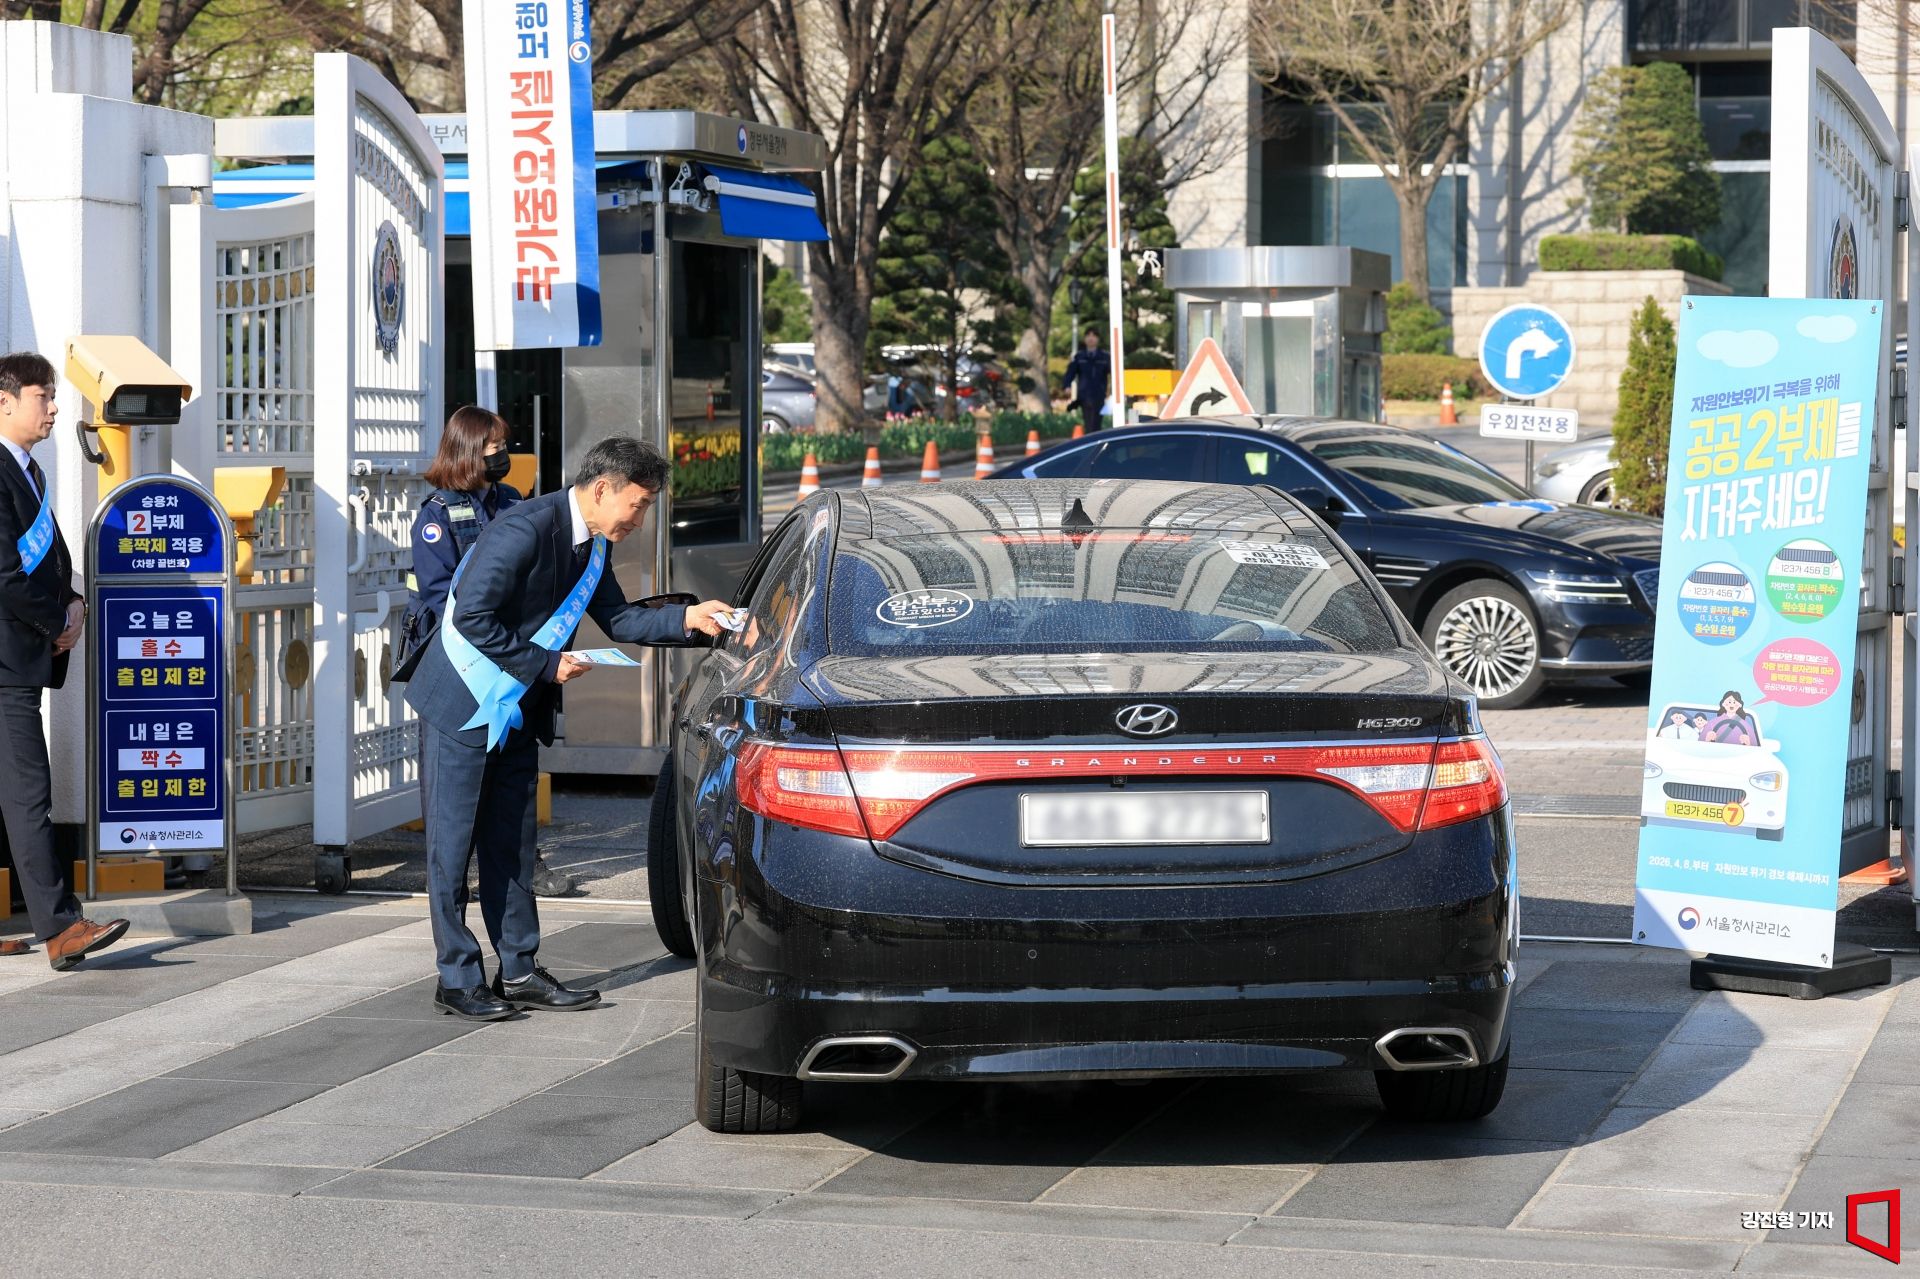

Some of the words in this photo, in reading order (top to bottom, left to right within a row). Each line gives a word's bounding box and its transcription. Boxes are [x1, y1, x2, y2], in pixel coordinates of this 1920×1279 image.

[427, 125, 468, 144] 부서
[750, 130, 787, 156] 정부서울청사
[509, 70, 560, 301] 국가중요시설
[1691, 385, 1770, 412] 자원안보위기
[1773, 377, 1812, 399] 극복을
[1814, 373, 1841, 393] 위해
[1488, 413, 1568, 434] 우회전전용
[1685, 412, 1742, 480] 공공
[1744, 397, 1862, 472] 2부제를
[141, 495, 179, 508] 승용차
[1680, 465, 1832, 543] 지켜주세요!
[132, 513, 184, 532] 2부제
[118, 537, 166, 554] 홀짝제
[171, 537, 203, 554] 적용
[131, 558, 155, 569] (차량
[157, 557, 191, 569] 끝번호)
[887, 595, 965, 612] 임산부가
[128, 610, 194, 630] 오늘은
[141, 638, 182, 657] 홀수
[129, 722, 194, 742] 내일은
[1356, 716, 1423, 730] HG300
[141, 750, 182, 768] 짝수
[1016, 755, 1277, 767] GRANDEUR
[1673, 804, 1700, 816] 123가
[139, 830, 204, 841] 서울청사관리소
[1706, 916, 1791, 938] 서울청사관리소
